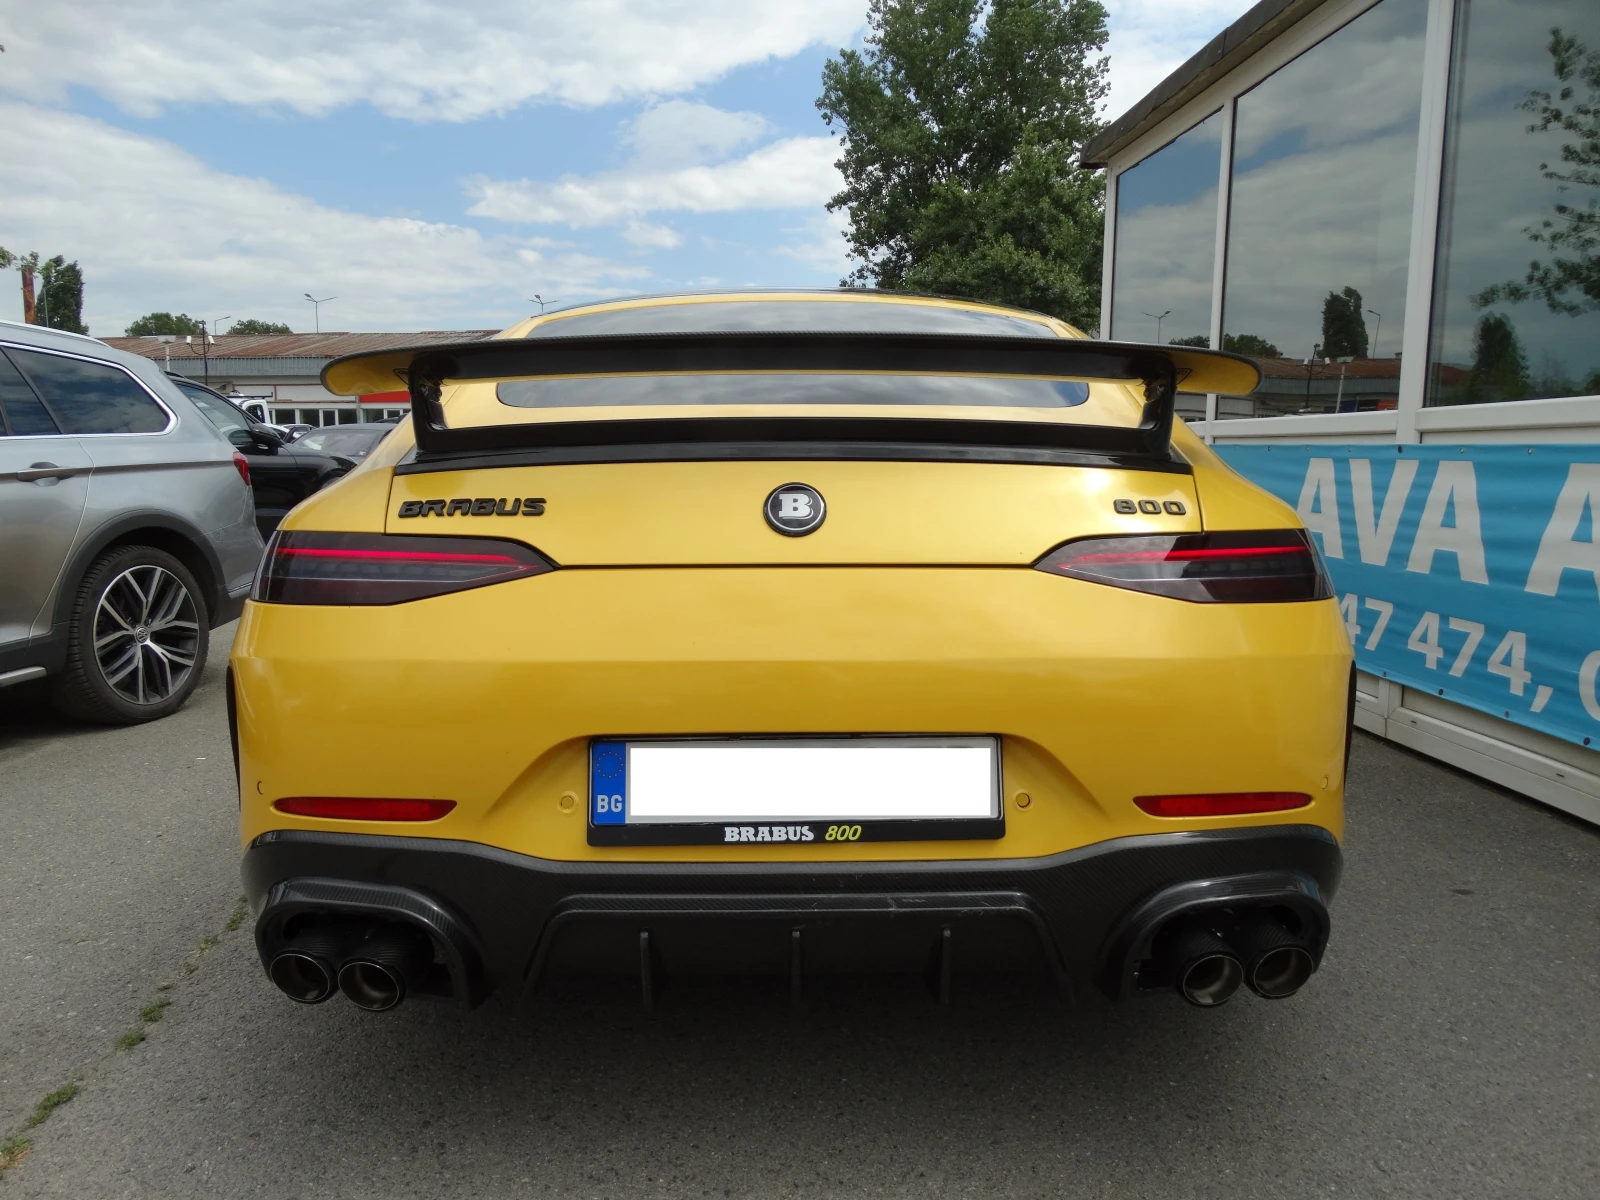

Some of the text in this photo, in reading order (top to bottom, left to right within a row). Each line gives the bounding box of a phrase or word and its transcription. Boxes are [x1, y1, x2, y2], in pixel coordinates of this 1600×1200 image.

[398, 498, 547, 518] BRABUS
[778, 493, 813, 519] B
[1113, 499, 1186, 515] 800
[1297, 457, 1489, 585] AVA
[1407, 611, 1554, 712] 474,
[597, 794, 622, 813] BG
[724, 825, 862, 842] BRABUS 800
